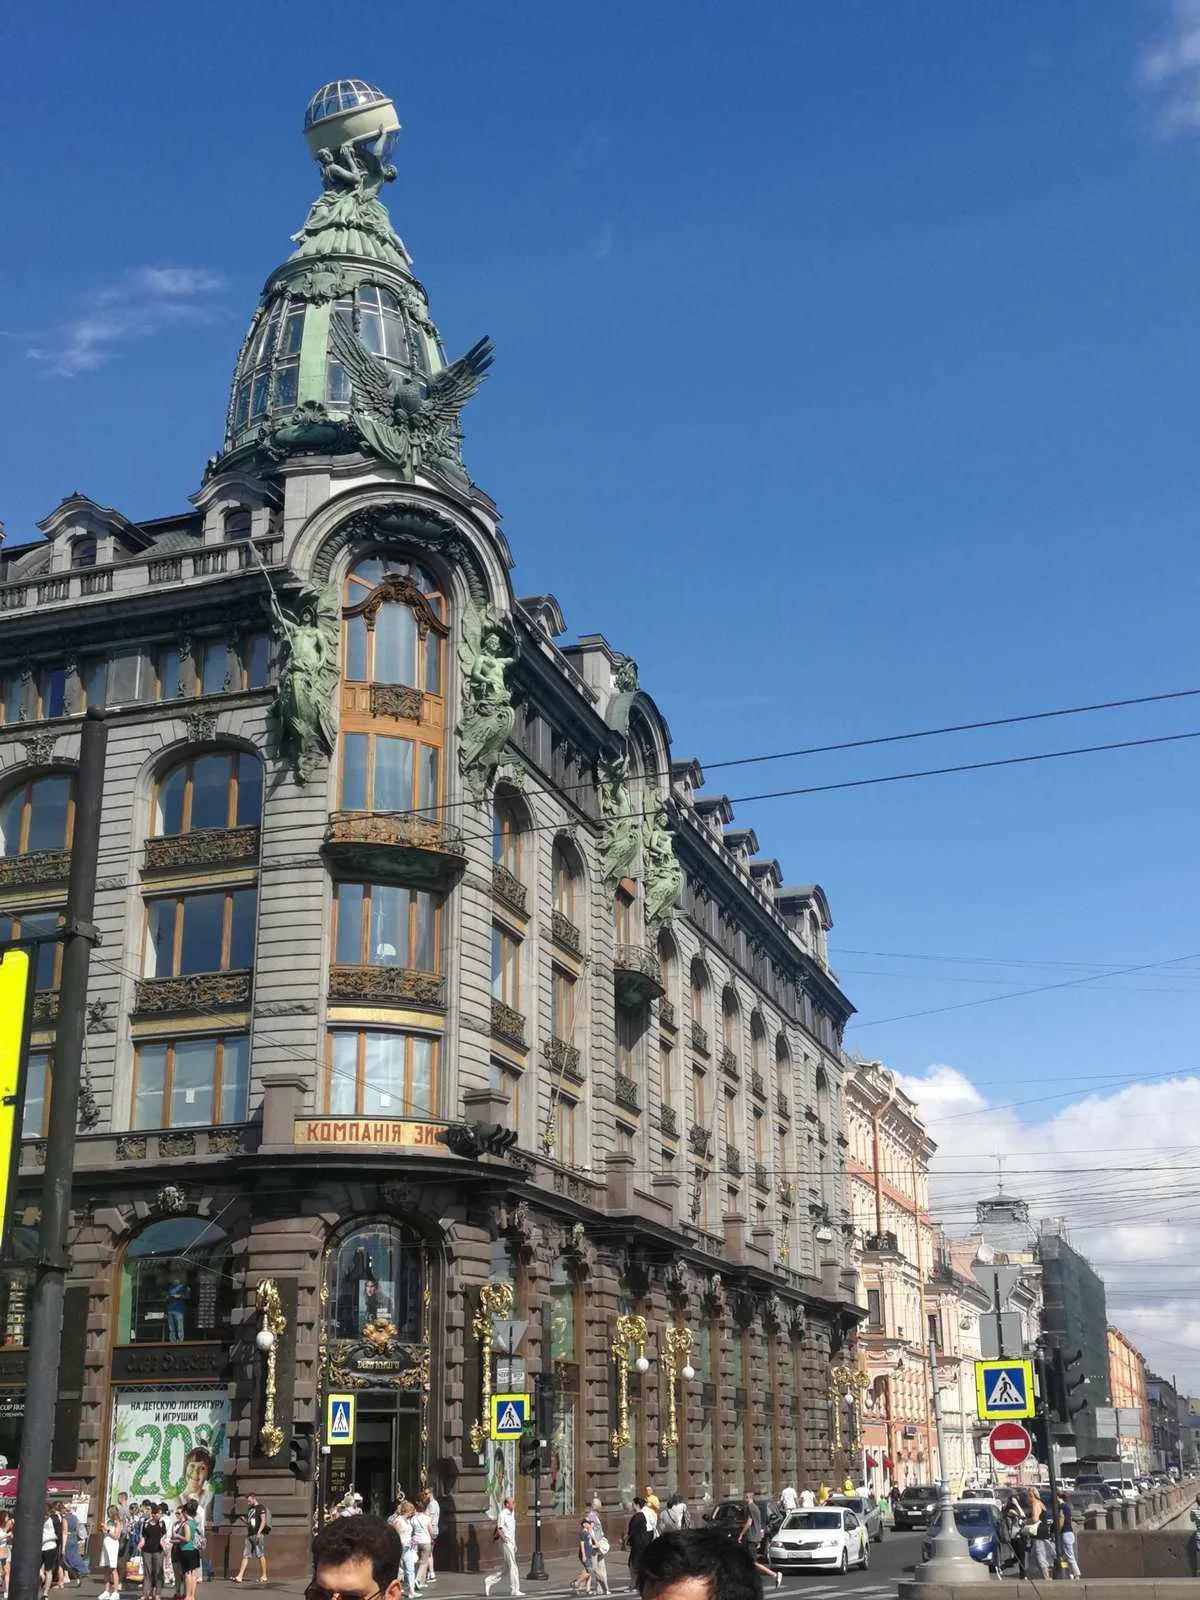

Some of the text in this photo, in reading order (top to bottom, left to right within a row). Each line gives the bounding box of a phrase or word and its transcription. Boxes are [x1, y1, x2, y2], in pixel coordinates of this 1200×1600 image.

[307, 1123, 401, 1142] КОМПАНІЯ
[130, 1399, 224, 1411] НА ДЕТСКУЮ ЛИТЕРАТУРУ
[155, 1411, 198, 1421] И ИГРУШКИ
